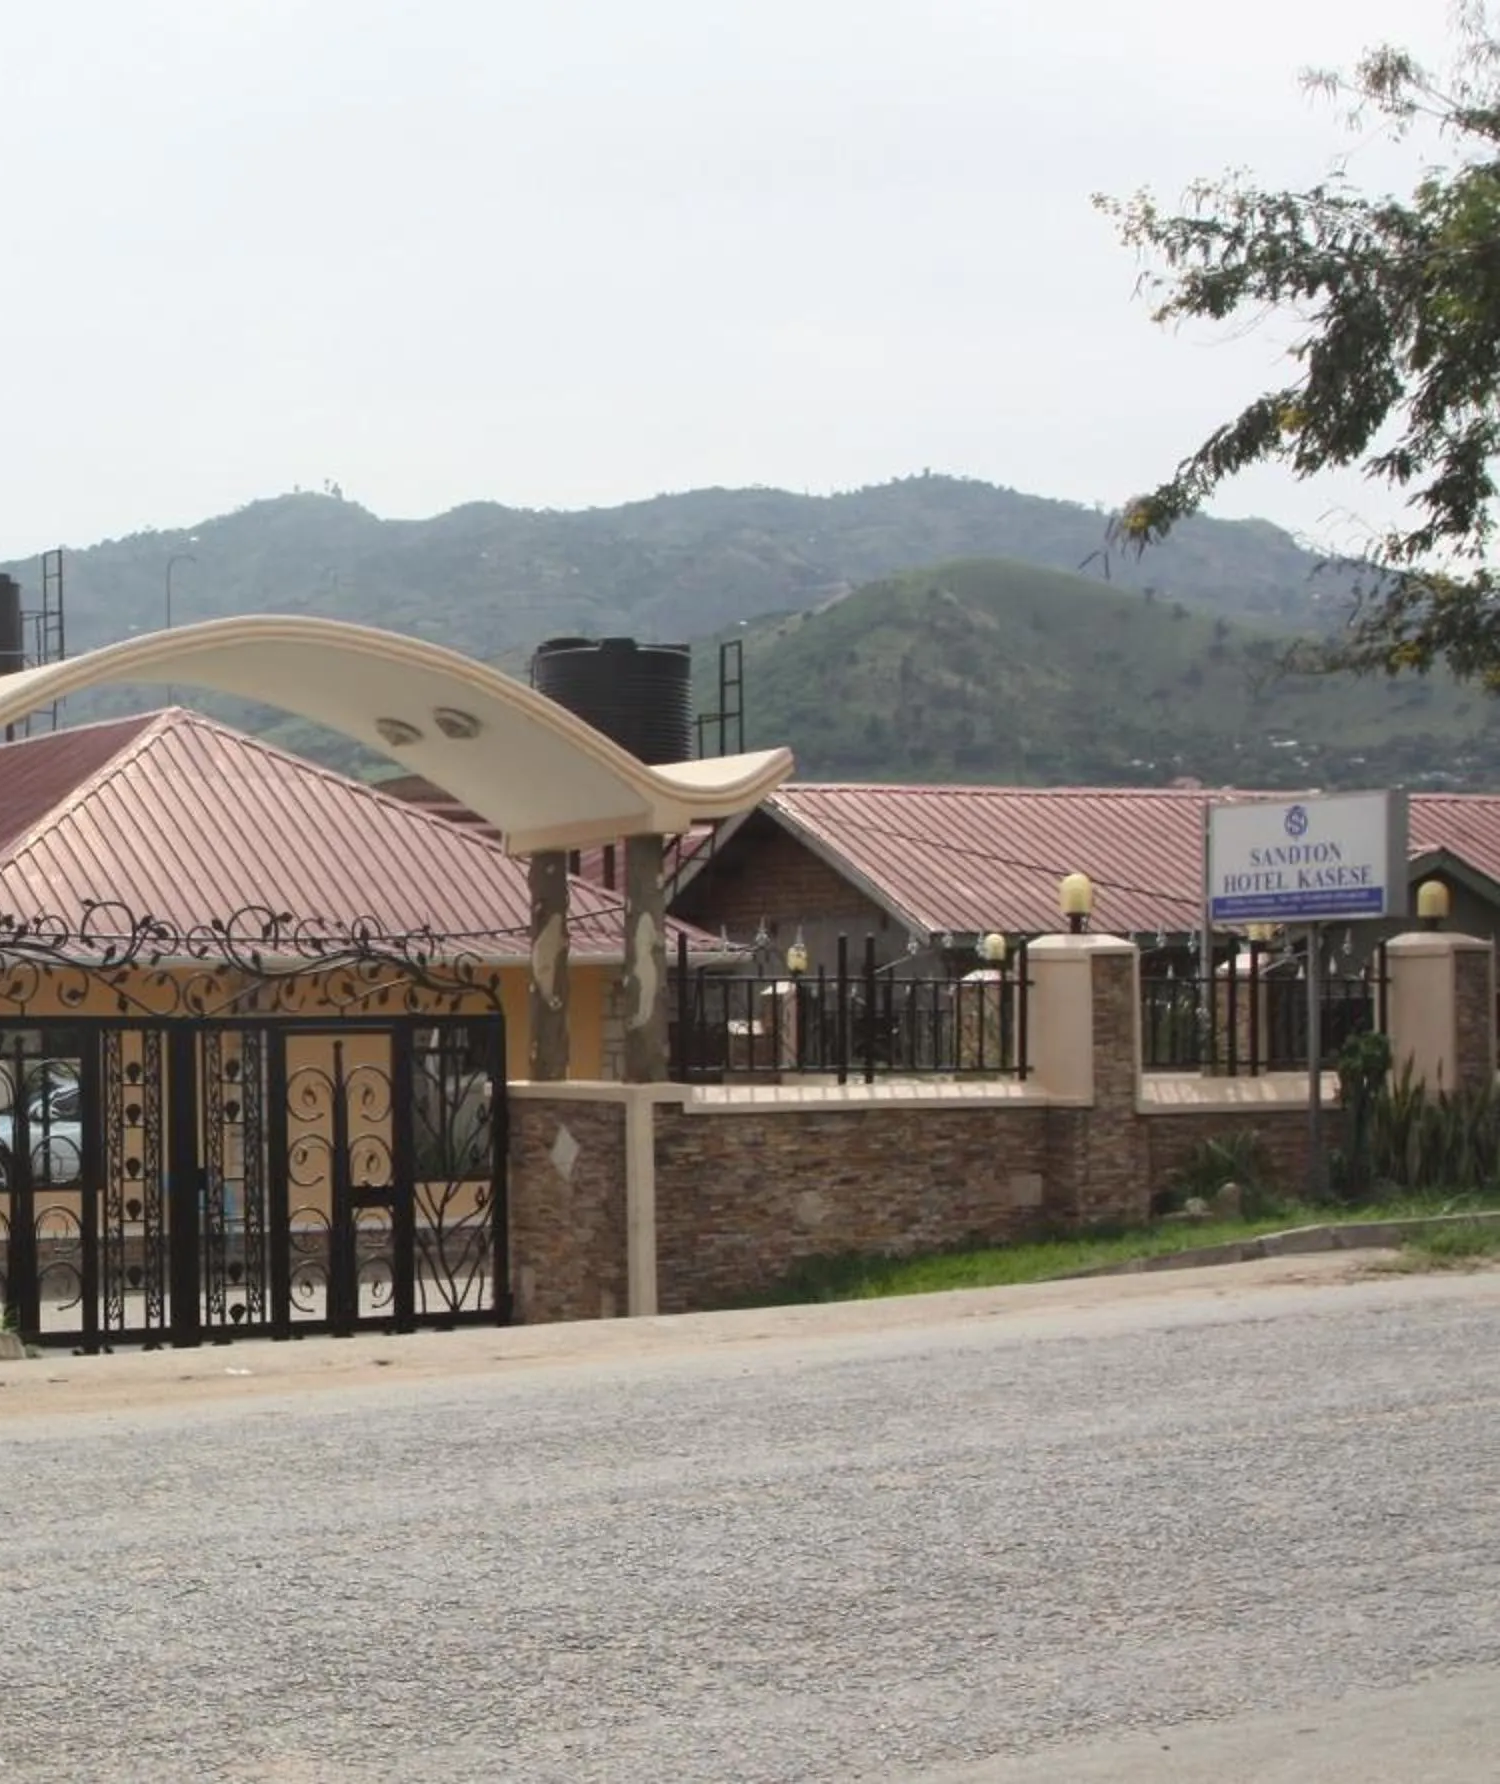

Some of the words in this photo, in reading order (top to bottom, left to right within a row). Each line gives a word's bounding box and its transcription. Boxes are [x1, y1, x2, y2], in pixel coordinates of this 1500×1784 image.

[1251, 842, 1341, 867] SANDTON
[1223, 871, 1289, 893] HOTEL
[1297, 864, 1373, 889] KASESE
